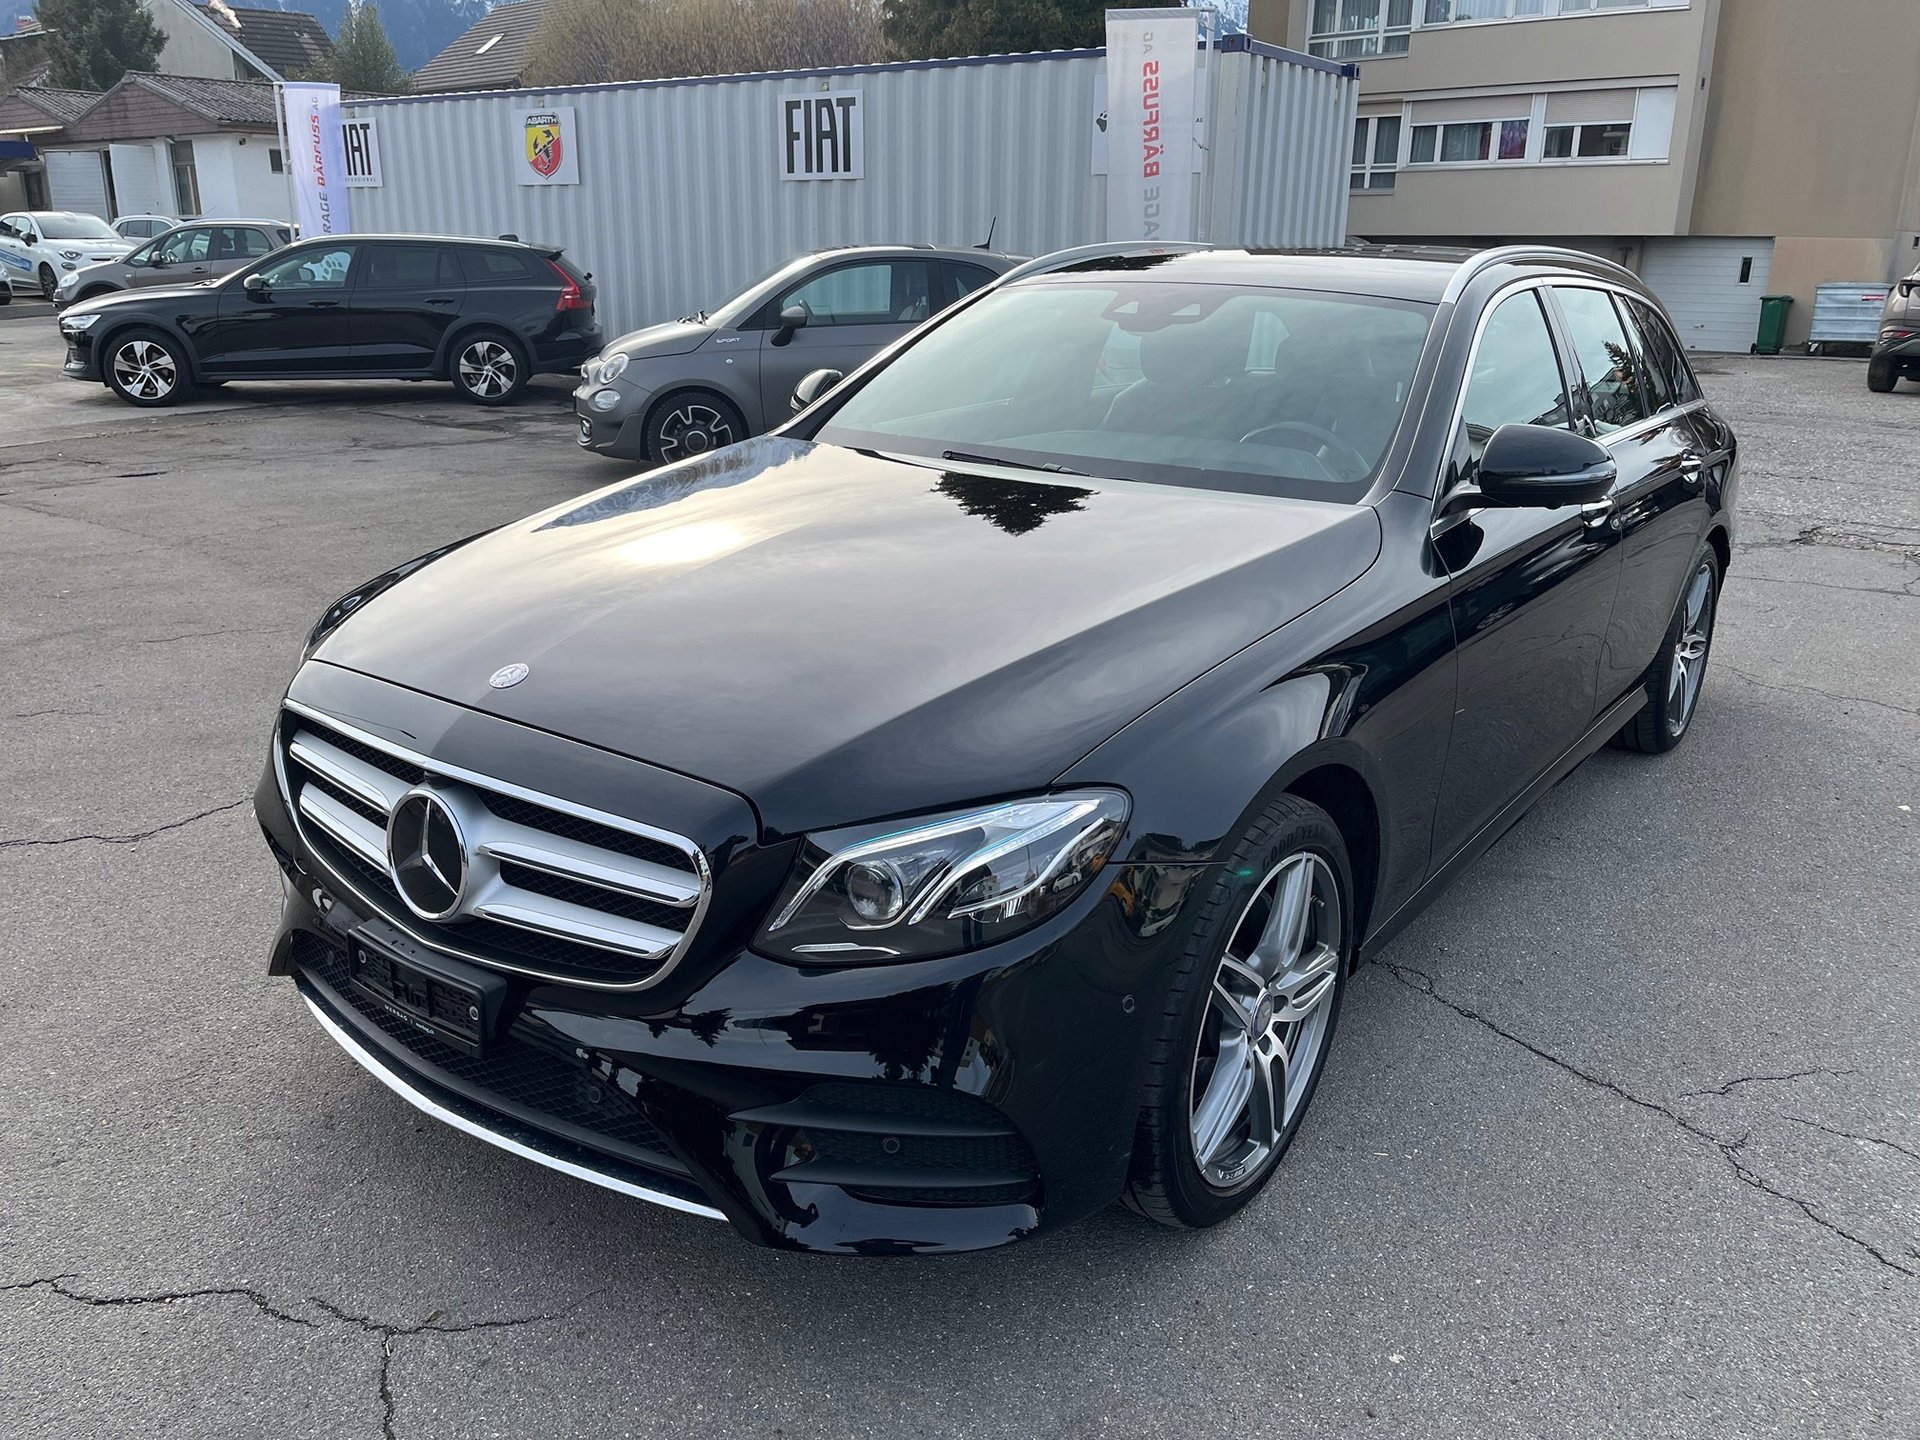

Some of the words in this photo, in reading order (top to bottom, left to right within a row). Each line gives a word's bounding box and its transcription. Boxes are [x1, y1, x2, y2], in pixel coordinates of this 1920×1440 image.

[311, 113, 326, 187] BÄRFUSS
[527, 116, 557, 124] ABARTH
[785, 97, 856, 174] FIAT
